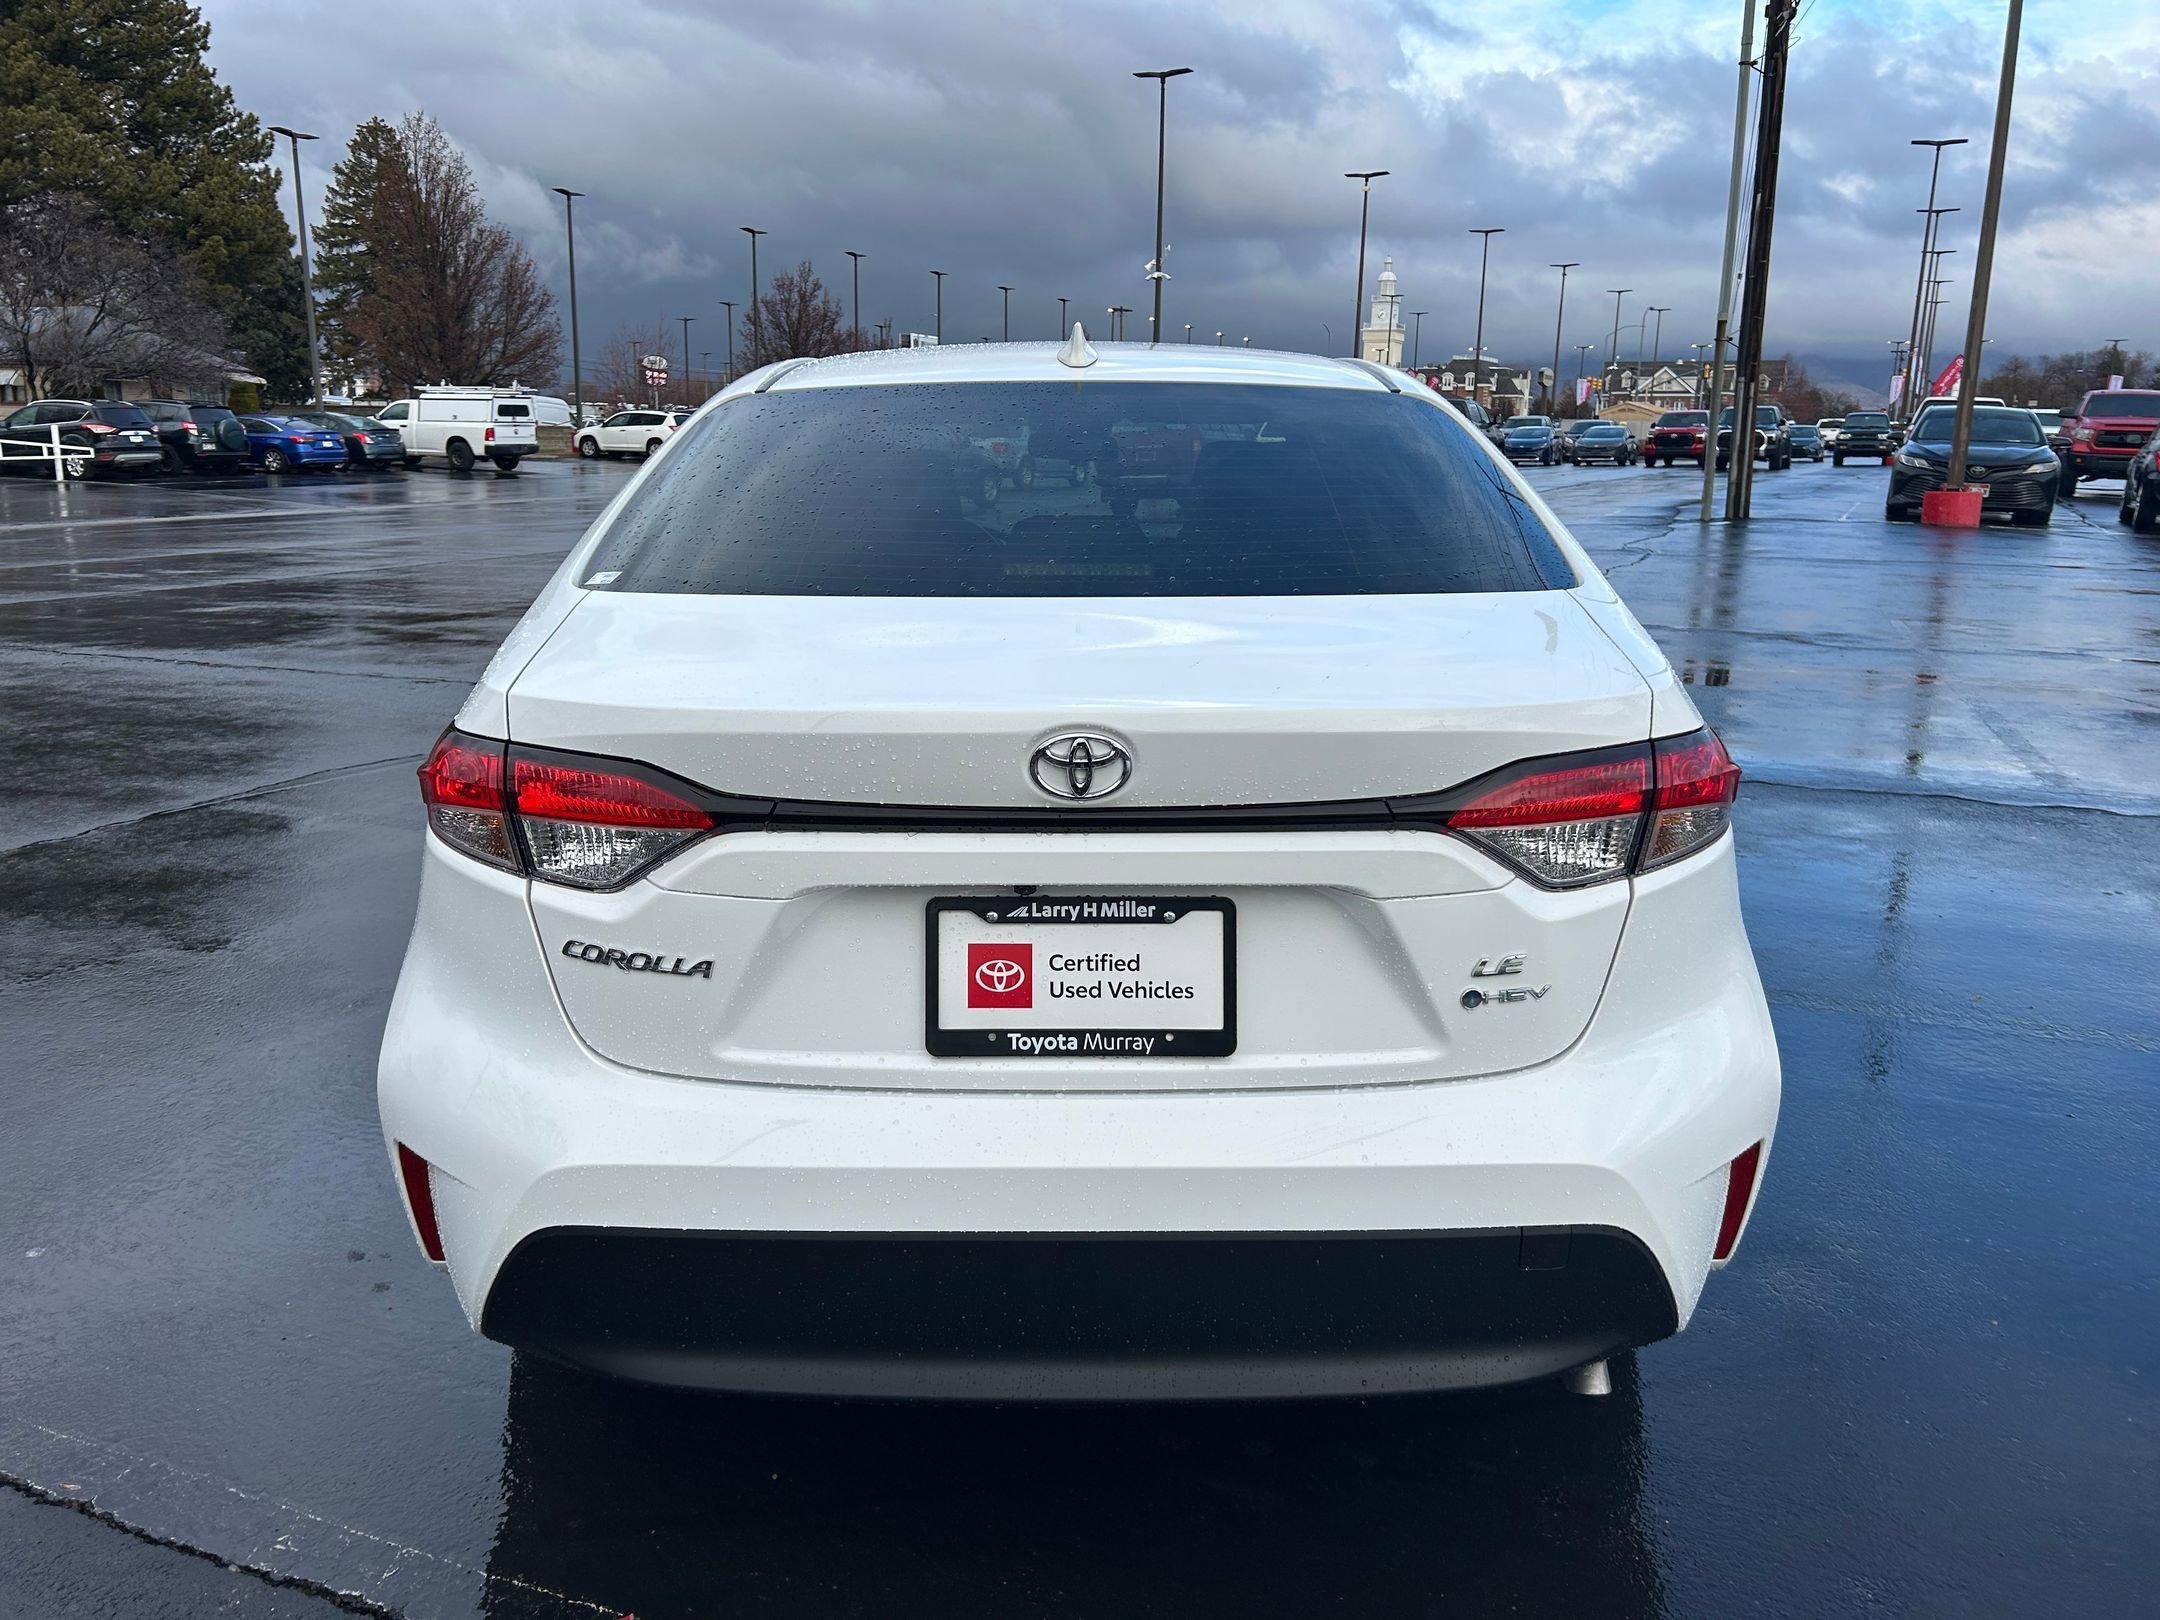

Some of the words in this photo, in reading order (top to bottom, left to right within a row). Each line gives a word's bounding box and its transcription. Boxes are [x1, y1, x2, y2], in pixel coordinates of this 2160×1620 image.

[1031, 901, 1081, 921] Larry
[1083, 901, 1098, 918] H
[1100, 901, 1157, 918] Miller
[562, 940, 715, 978] COROLLA
[1048, 953, 1141, 973] Certified
[1471, 953, 1528, 977] LE
[1049, 980, 1103, 999] Used
[1107, 980, 1195, 1000] Vehicles
[1007, 1033, 1079, 1054] Toyota
[1083, 1033, 1155, 1055] Murray
